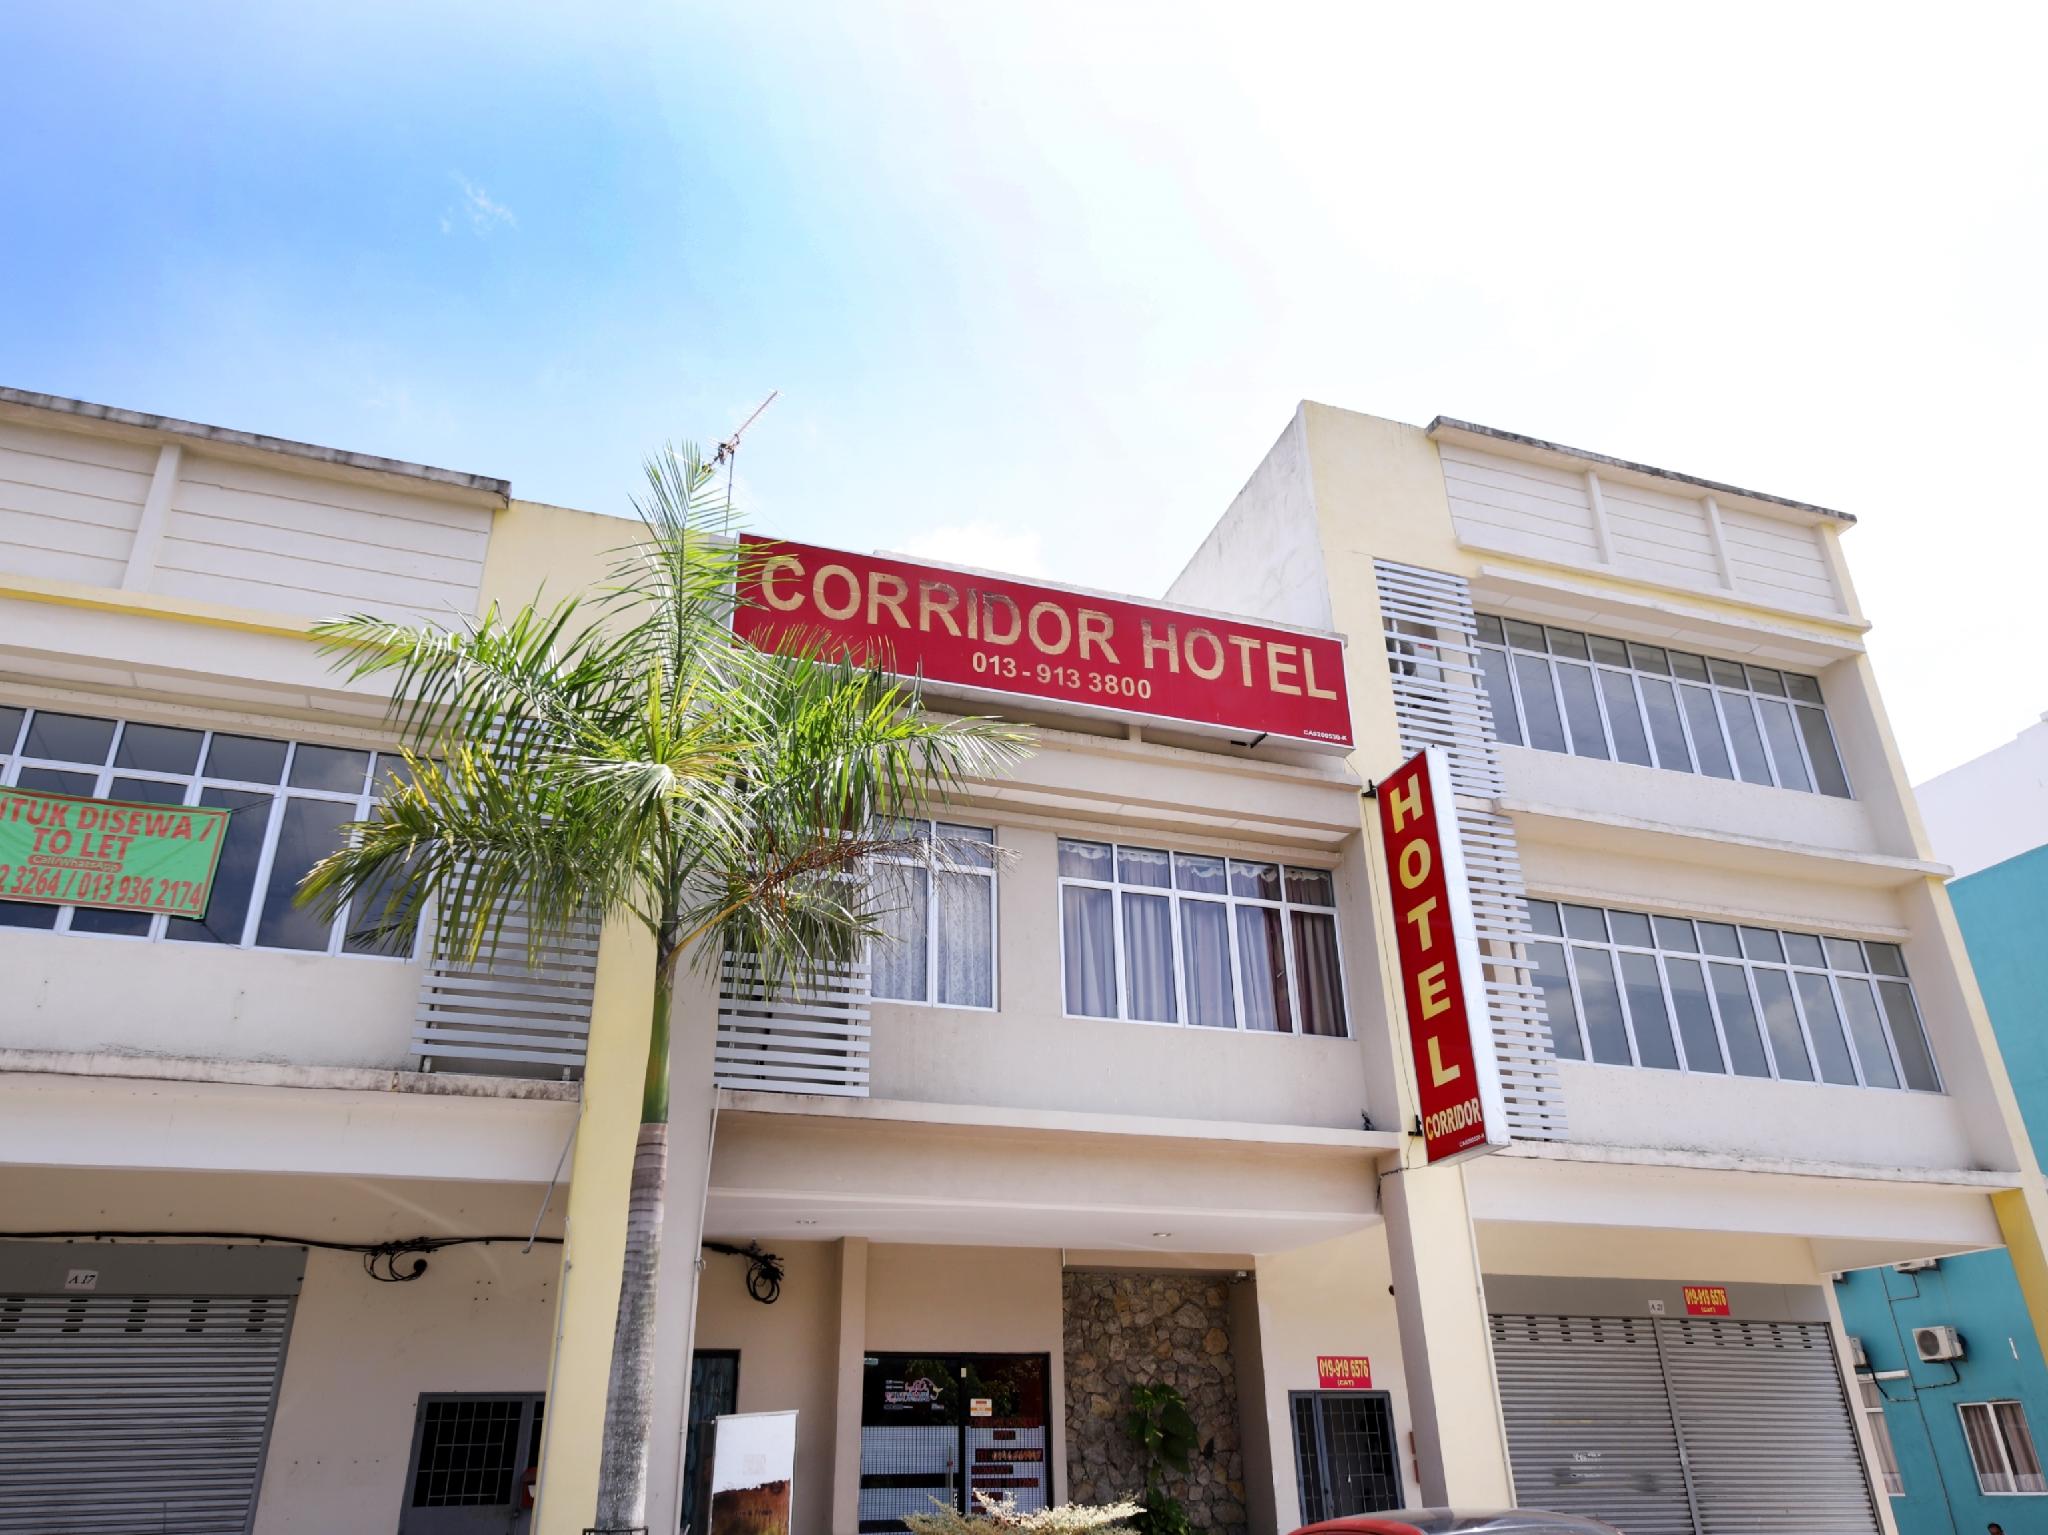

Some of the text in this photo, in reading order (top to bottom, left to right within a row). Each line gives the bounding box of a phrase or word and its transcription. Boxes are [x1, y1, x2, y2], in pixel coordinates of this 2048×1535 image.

[761, 556, 1337, 701] CORRIDOR HOTEL
[972, 652, 1017, 678] 013
[1036, 662, 1081, 689] 913
[1088, 672, 1151, 699] 3800
[33, 827, 133, 859] TO LET
[78, 807, 191, 839] DISEWA
[11, 866, 59, 895] 3264
[78, 872, 113, 899] 013
[118, 876, 155, 904] 936
[156, 879, 201, 909] 2174
[1389, 772, 1461, 1088] HOTEL
[1425, 1096, 1482, 1141] CORRIDOR
[68, 1274, 95, 1284] A 17
